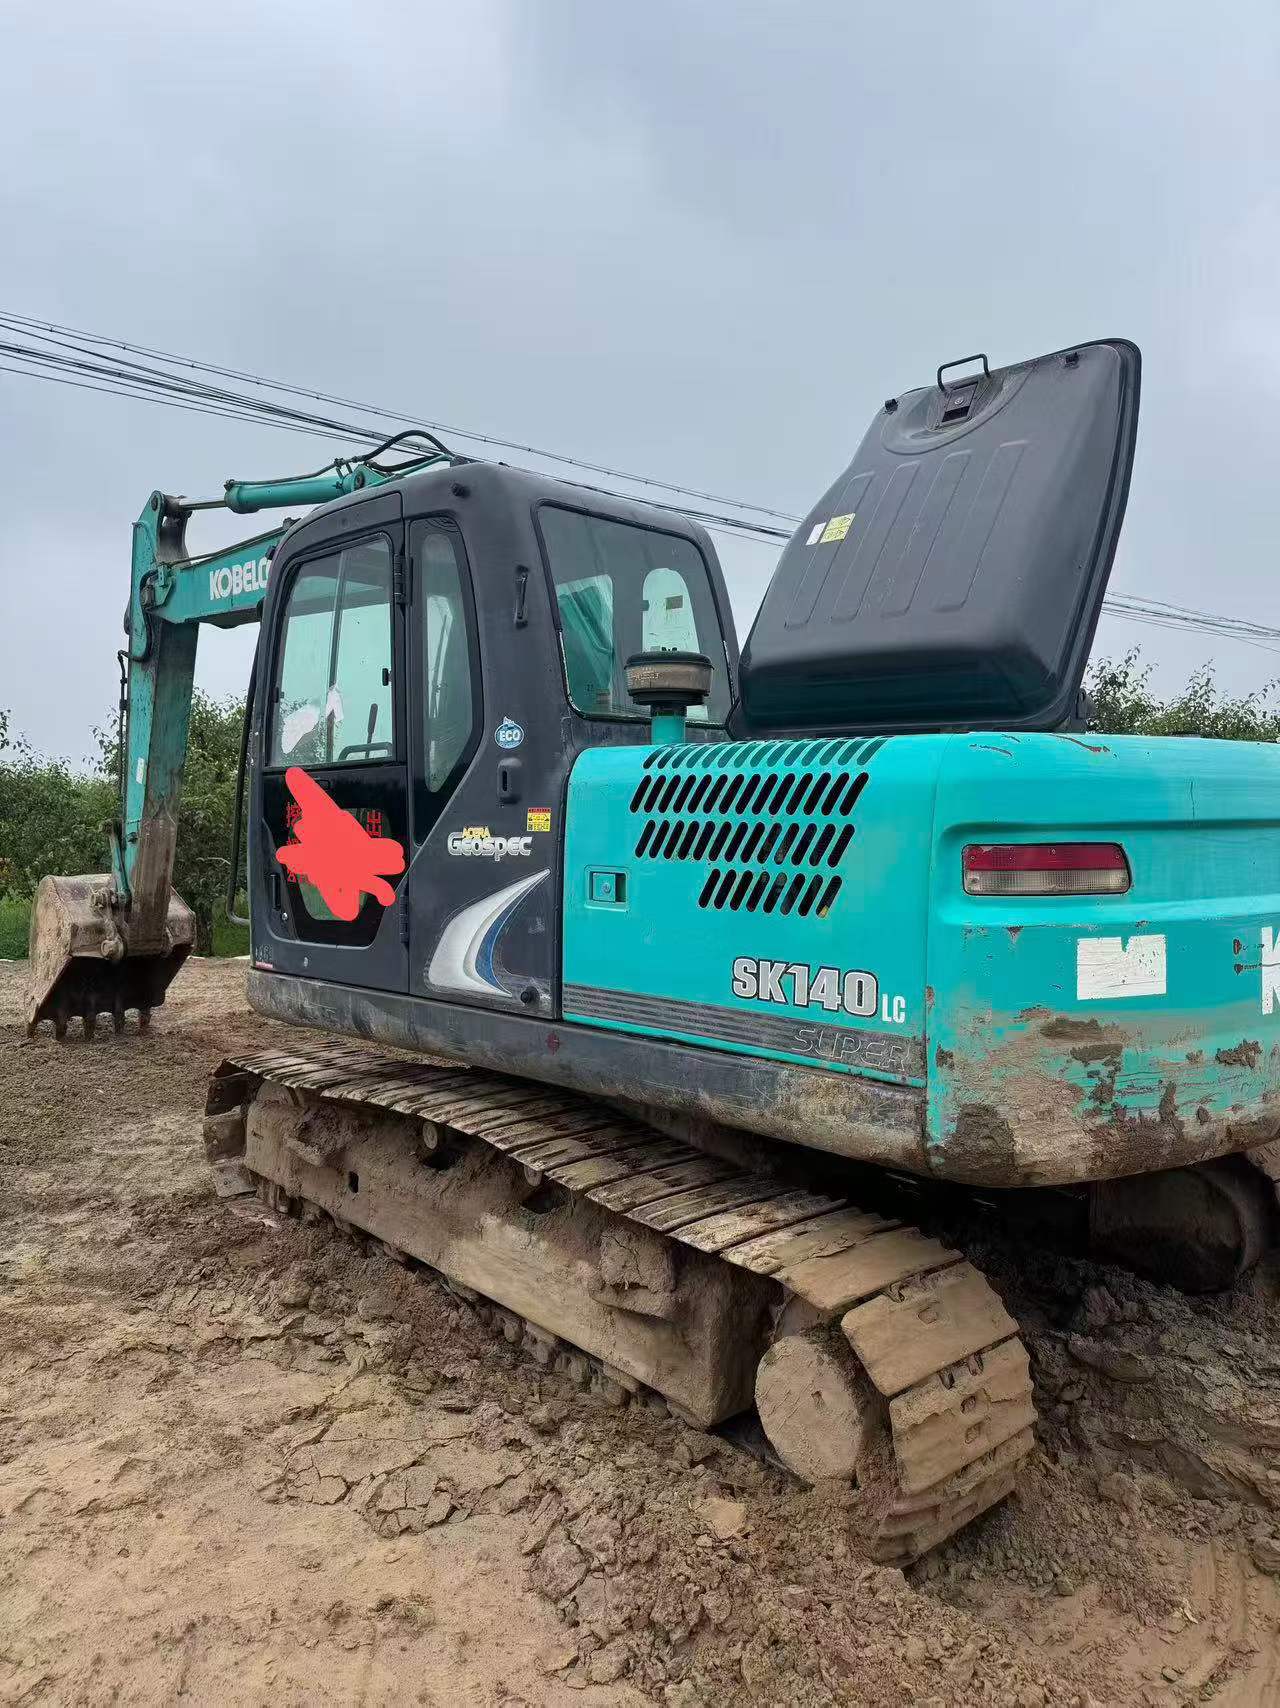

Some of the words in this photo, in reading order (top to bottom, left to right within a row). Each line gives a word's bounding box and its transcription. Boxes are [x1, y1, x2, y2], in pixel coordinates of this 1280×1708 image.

[499, 729, 521, 742] ECO
[732, 955, 879, 1018] SK140
[881, 993, 907, 1024] LC
[791, 1027, 910, 1073] SUPER
